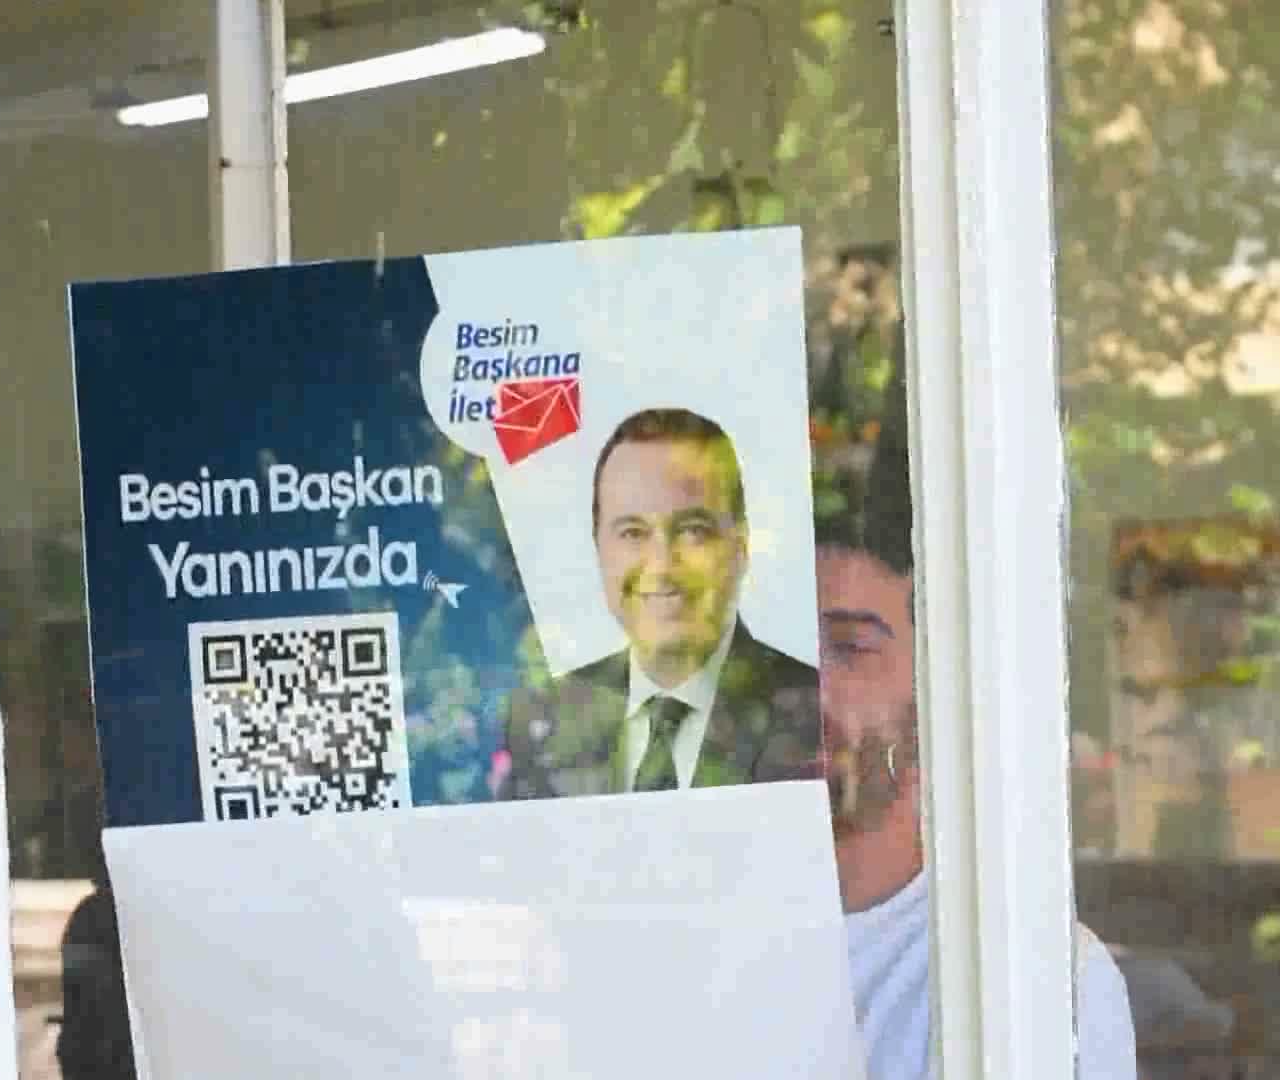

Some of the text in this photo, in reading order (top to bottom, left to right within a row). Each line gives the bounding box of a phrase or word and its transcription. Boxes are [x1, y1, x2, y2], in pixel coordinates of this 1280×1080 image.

[456, 318, 539, 350] Besim
[453, 351, 581, 382] Başkana
[449, 390, 496, 423] İlet
[120, 456, 444, 523] Besim Başkan
[147, 526, 418, 599] Yanınızda
